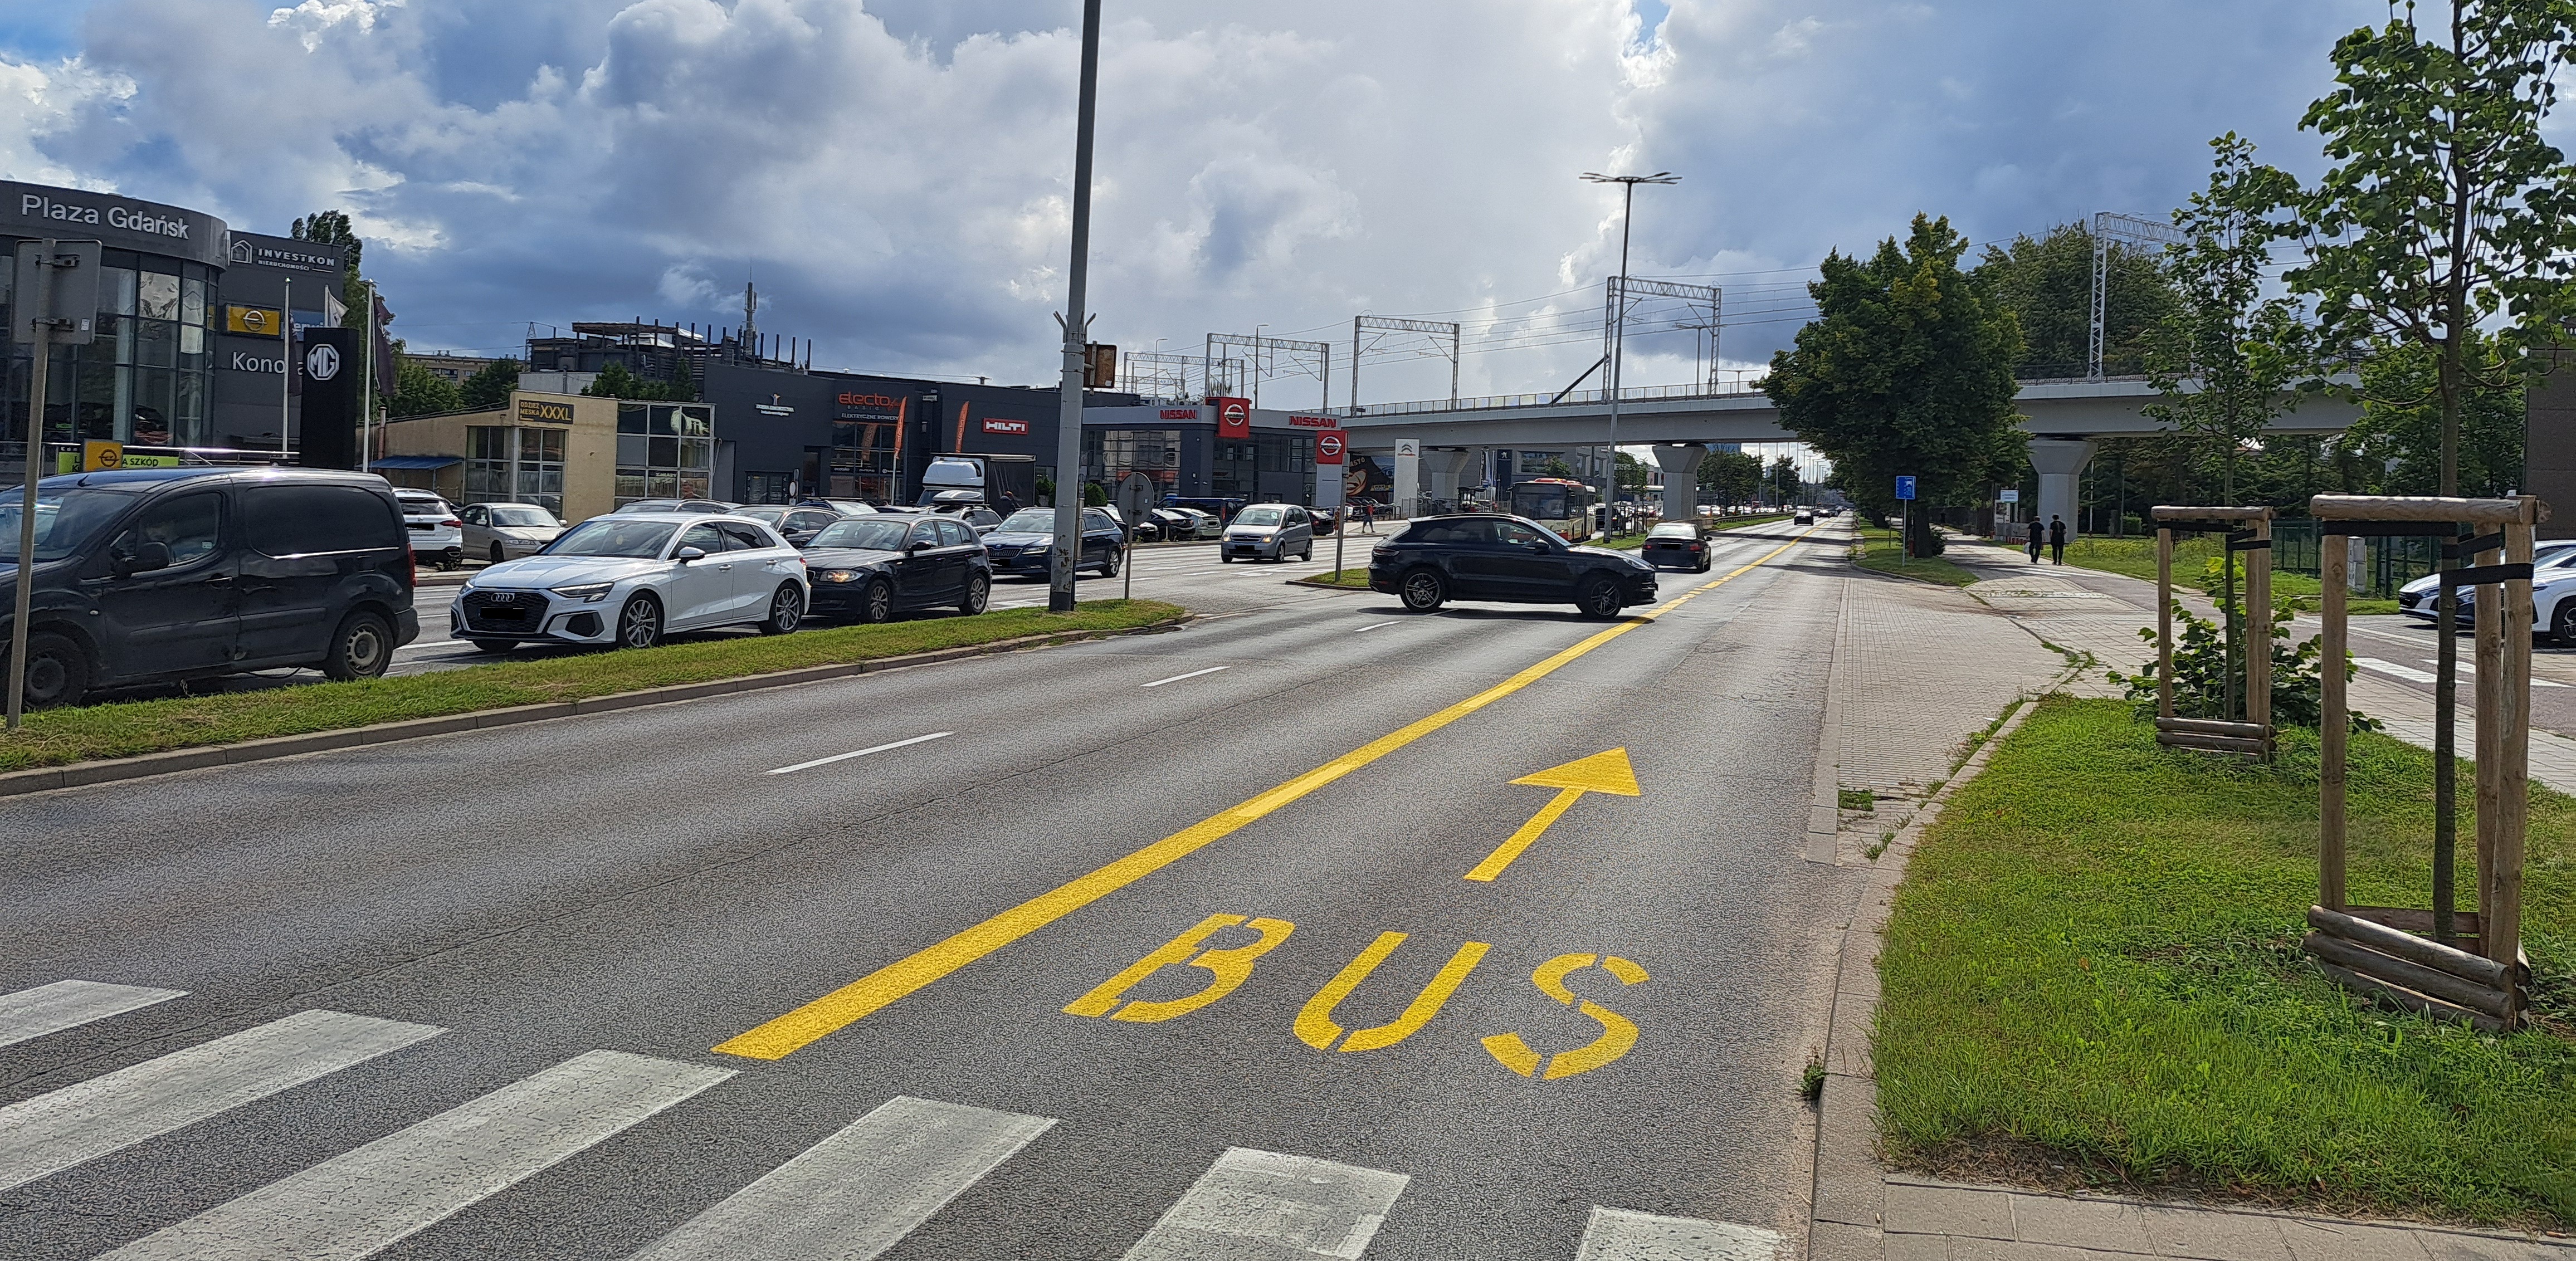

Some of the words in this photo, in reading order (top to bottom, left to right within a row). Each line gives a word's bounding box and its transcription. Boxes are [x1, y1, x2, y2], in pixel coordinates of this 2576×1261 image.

[22, 194, 99, 224] Plaza
[107, 206, 189, 240] Gdańsk
[258, 248, 335, 266] INVESTKON
[258, 260, 310, 271] NIERUCHOMOŚCI
[310, 347, 335, 377] MG
[539, 404, 572, 421] XXXL
[1160, 409, 1197, 419] NISSAN
[985, 421, 1026, 432] HILTI
[1289, 416, 1336, 428] NISSAN
[130, 457, 159, 467] SZKÓD
[1350, 457, 1365, 467] ASTO
[1062, 912, 1650, 1080] BUS
